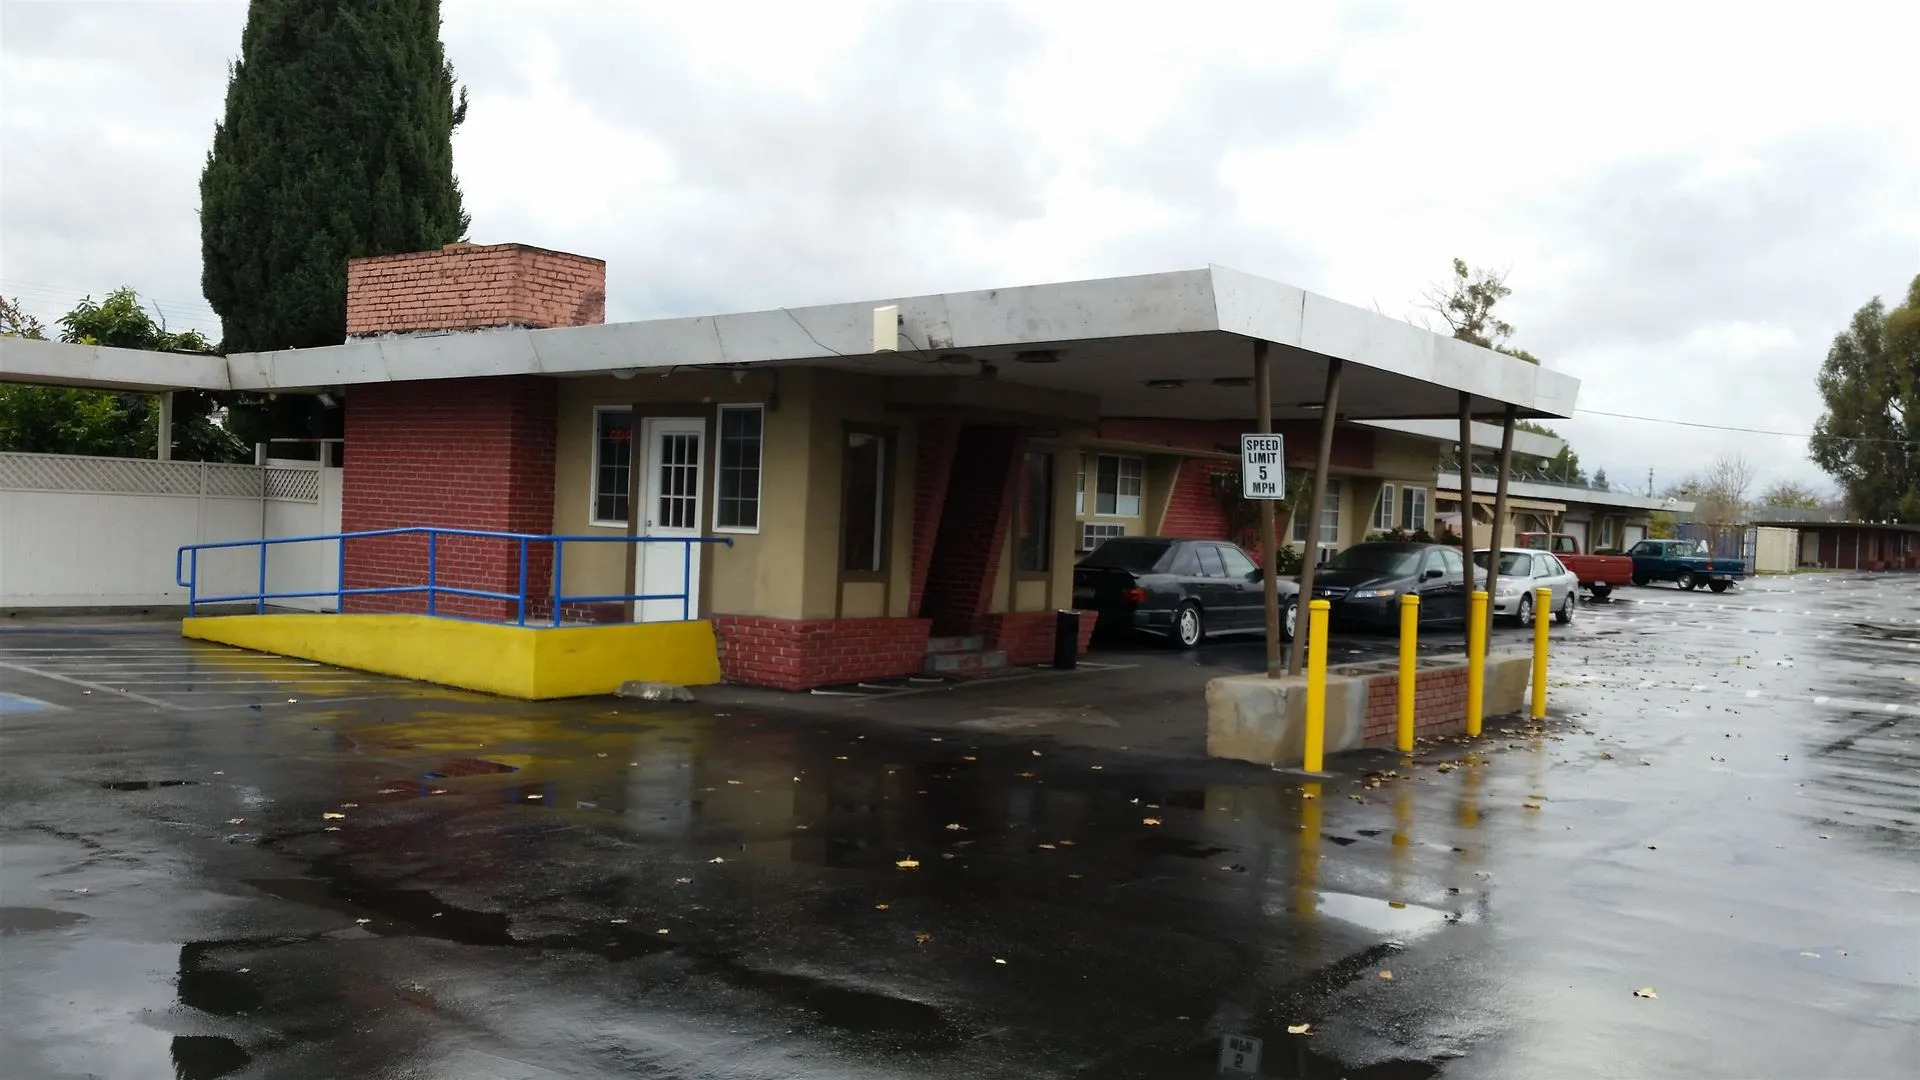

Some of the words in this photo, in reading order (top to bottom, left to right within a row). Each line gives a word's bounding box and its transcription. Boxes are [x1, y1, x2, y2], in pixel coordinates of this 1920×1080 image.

[1246, 439, 1279, 451] SPEED
[1248, 452, 1277, 464] LIMIT
[1259, 465, 1268, 480] 5
[1252, 482, 1276, 494] MPH
